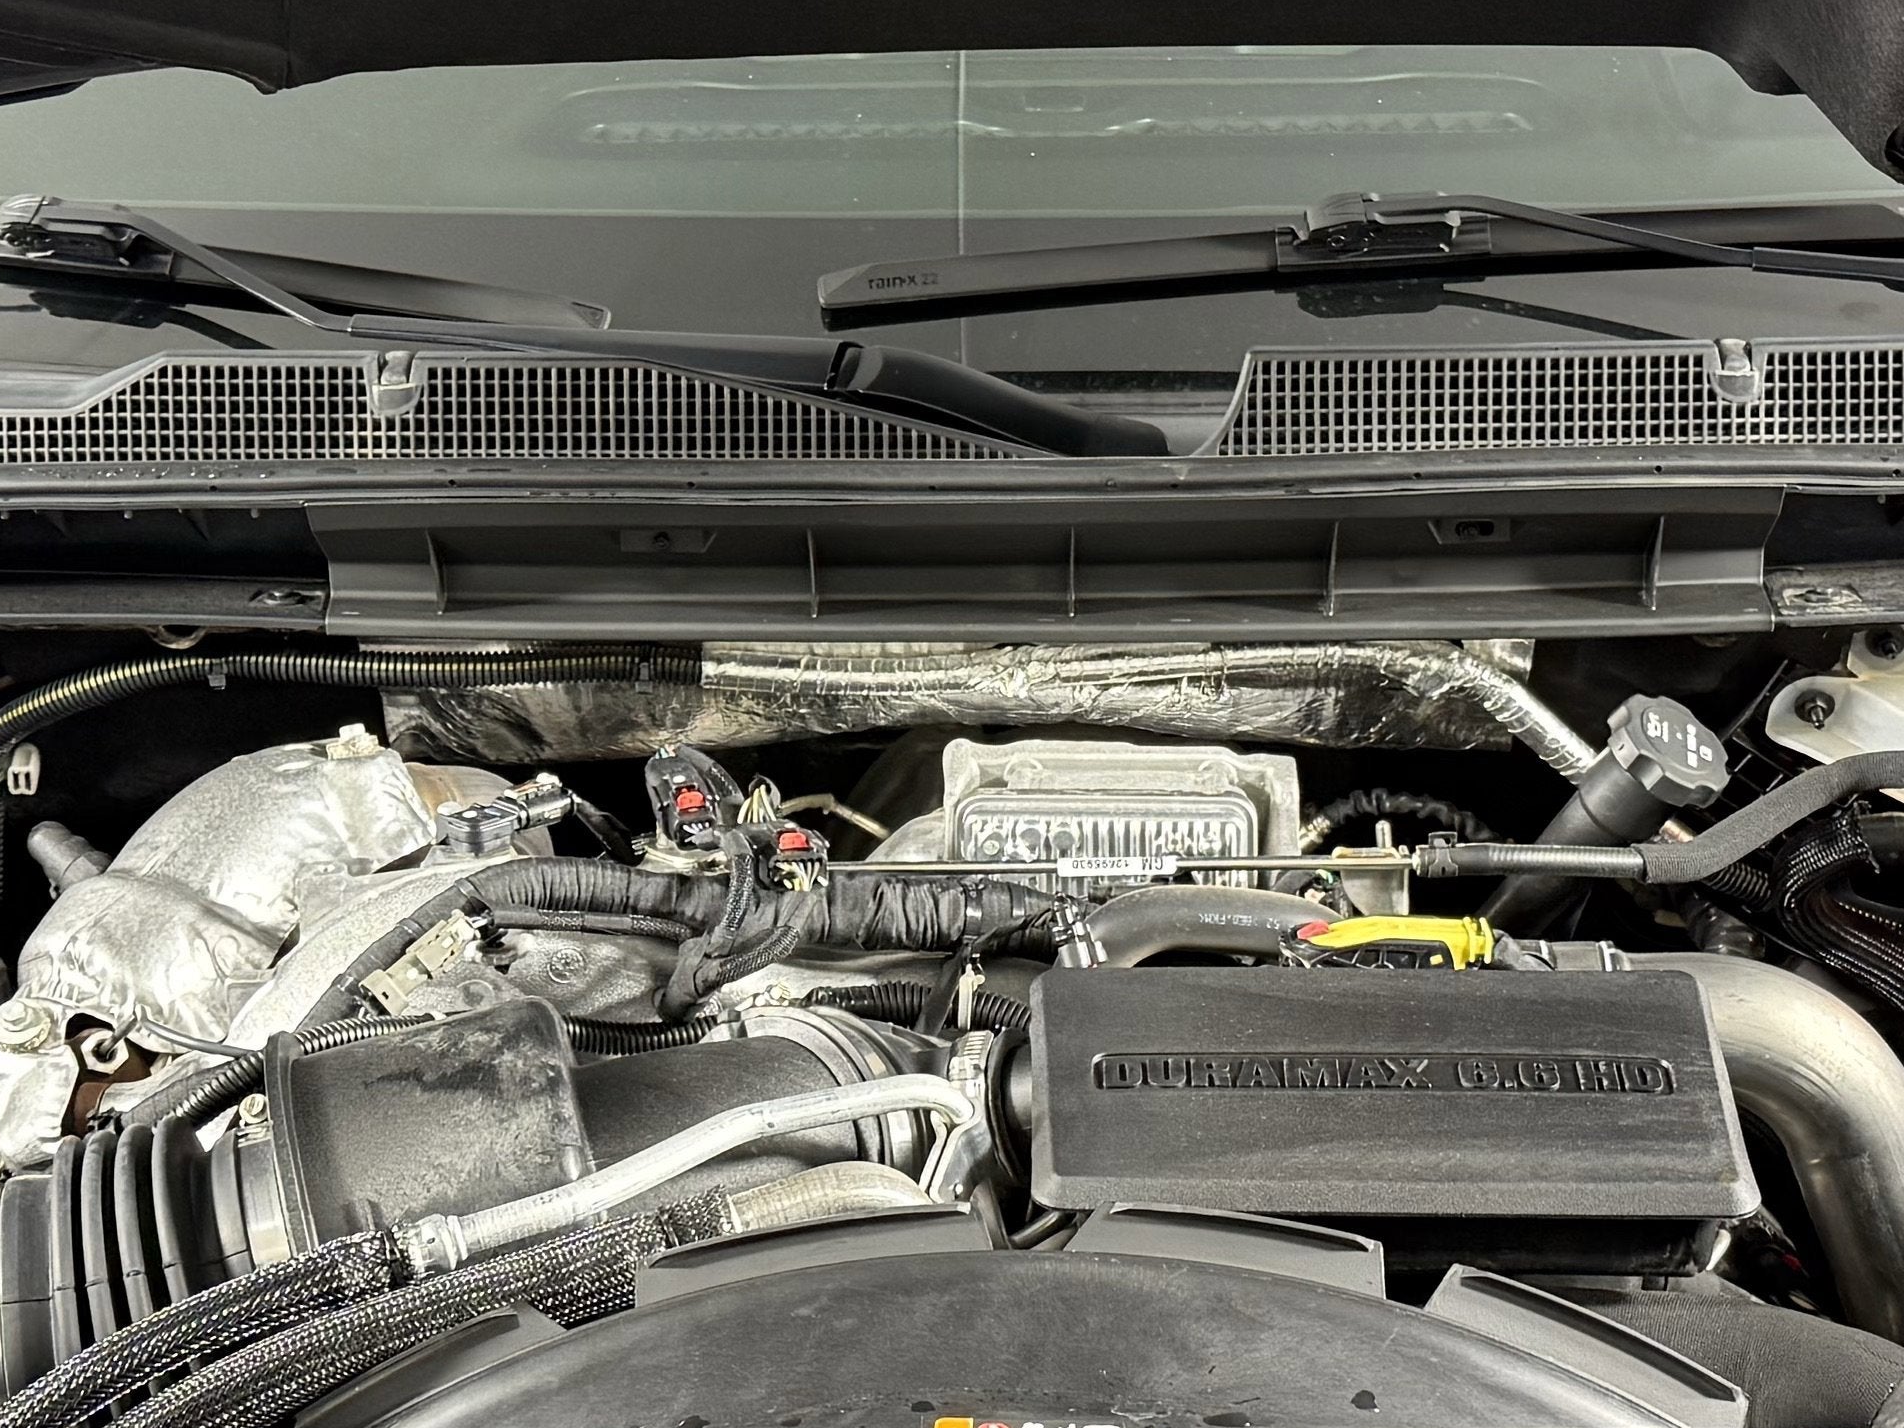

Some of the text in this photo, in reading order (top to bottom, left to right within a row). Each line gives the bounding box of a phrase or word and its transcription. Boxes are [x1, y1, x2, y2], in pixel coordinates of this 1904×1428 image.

[1141, 857, 1163, 870] GM
[1102, 1058, 1667, 1093] DURAMAX 6.6 HD
